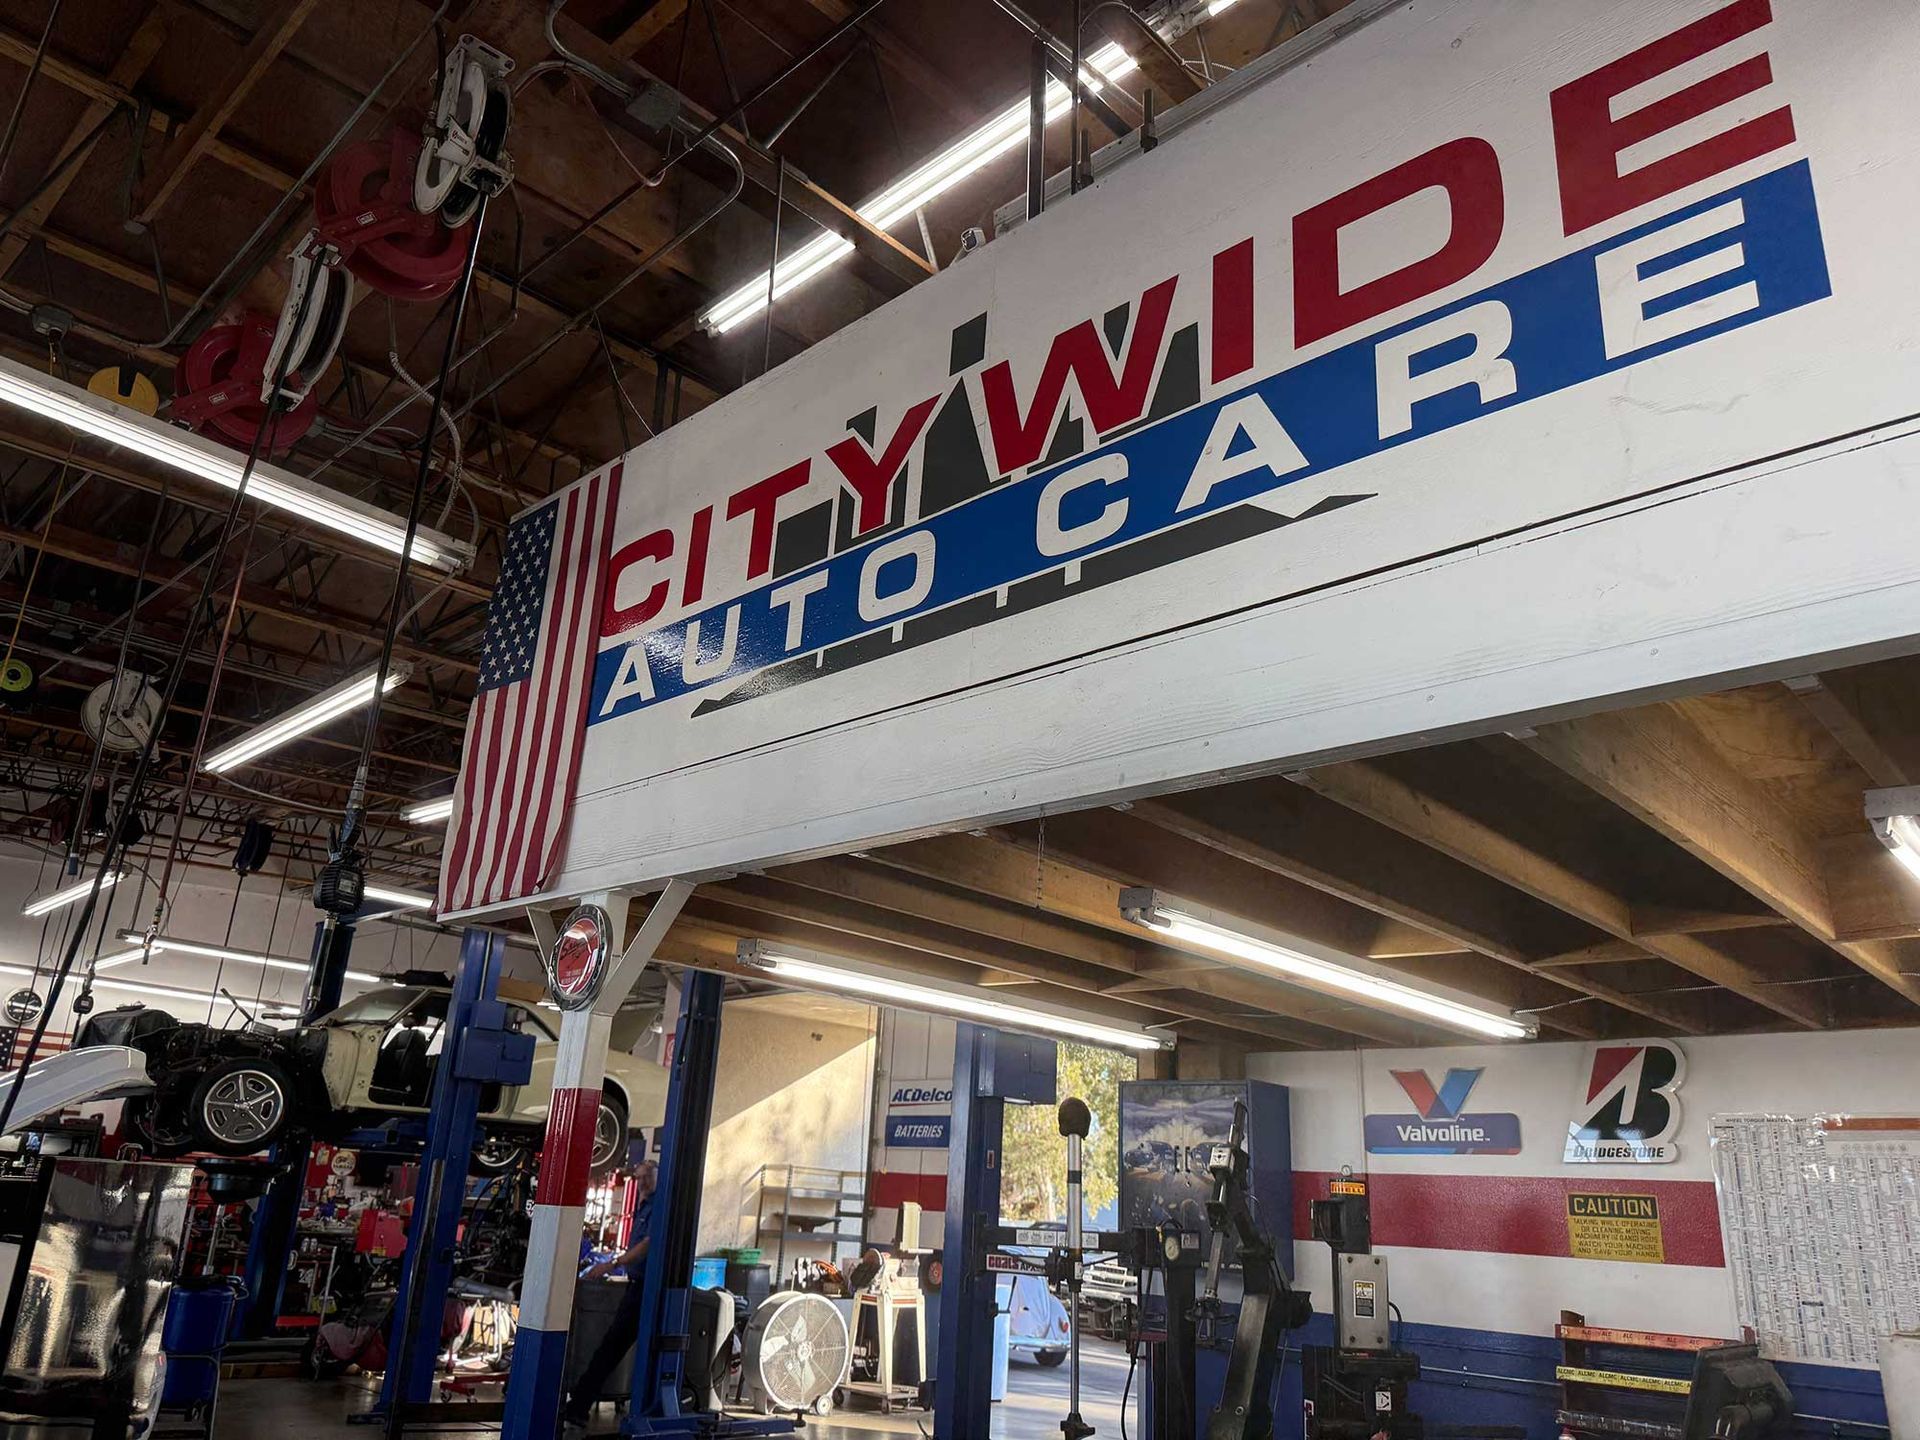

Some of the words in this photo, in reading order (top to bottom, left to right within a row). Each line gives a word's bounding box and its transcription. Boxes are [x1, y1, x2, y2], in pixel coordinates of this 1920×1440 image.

[599, 0, 1797, 637] CITYWIDE
[599, 530, 936, 717] AUTO
[1036, 198, 1760, 557] CARE
[892, 1088, 953, 1102] ACDelco
[894, 1124, 944, 1138] BATTERIES
[1397, 1125, 1485, 1142] Valvoline
[1574, 1147, 1665, 1158] BRIDGESTONE
[1573, 1197, 1652, 1216] CAUTION
